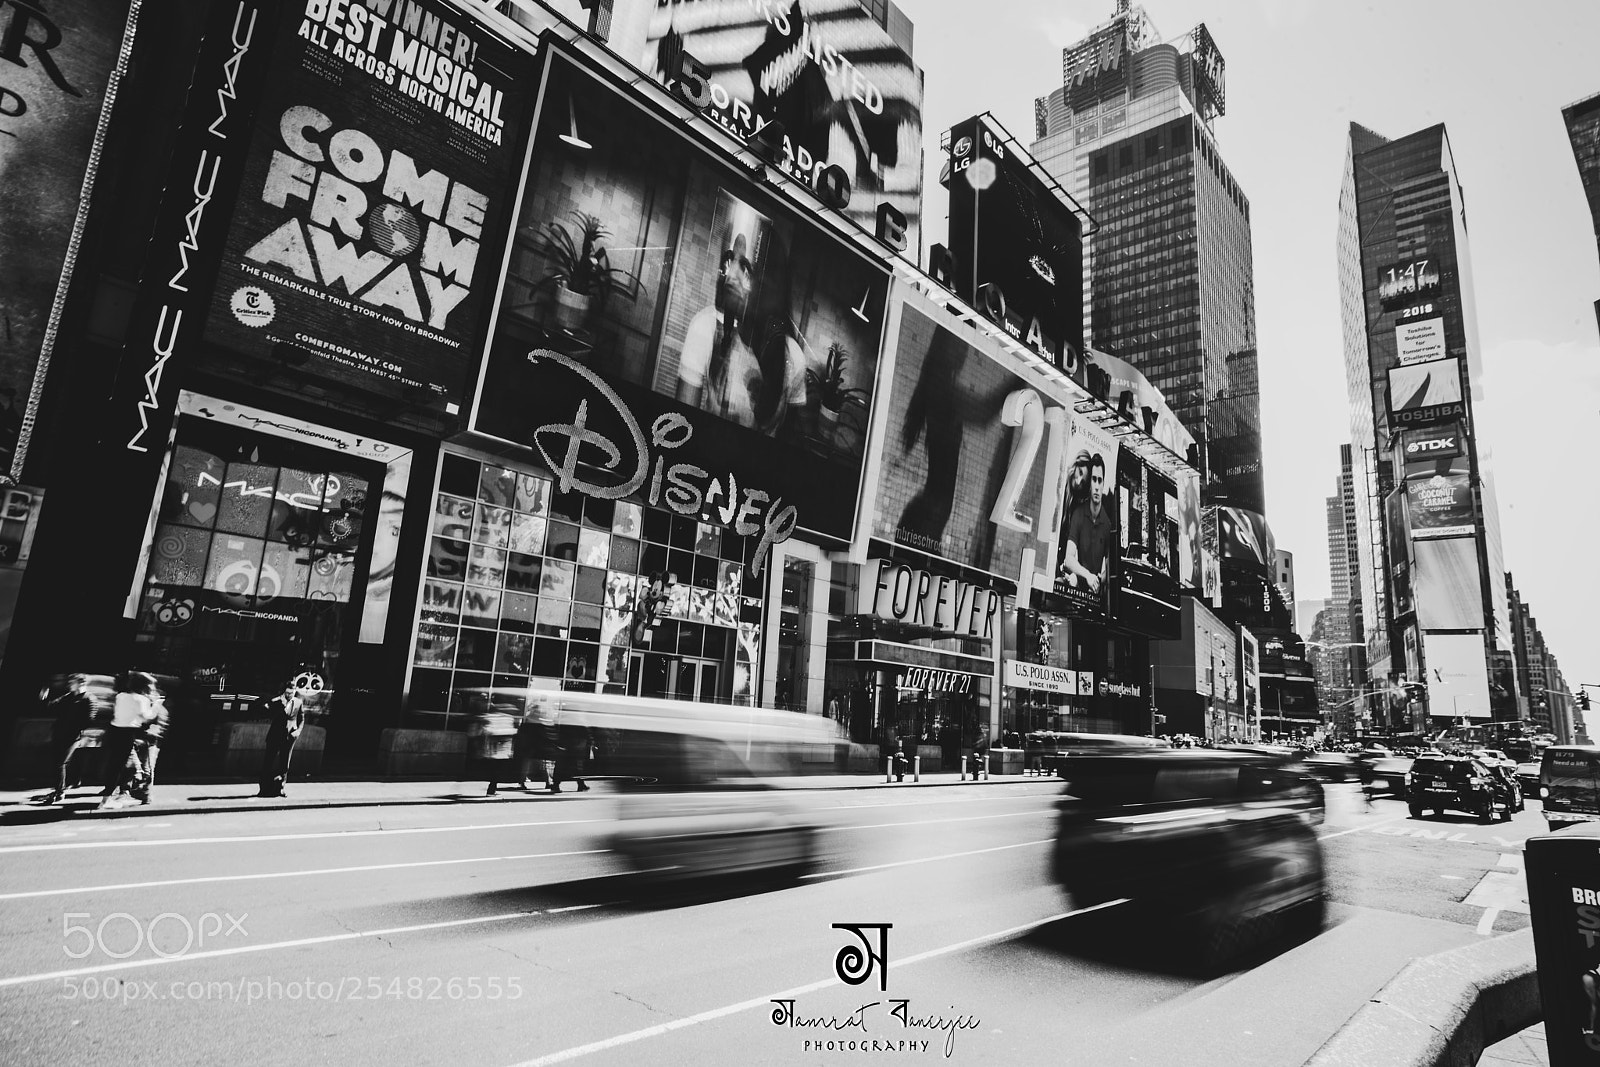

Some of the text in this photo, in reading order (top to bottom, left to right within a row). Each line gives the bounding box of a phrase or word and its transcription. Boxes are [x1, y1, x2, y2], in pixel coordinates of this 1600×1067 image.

[304, 0, 505, 128] BEST MUSICAL
[802, 21, 884, 115] LISTED
[297, 18, 503, 147] ALL ACROSS NORTH AMERICA
[993, 139, 1004, 159] LG
[279, 104, 491, 241] COME
[953, 157, 970, 173] LG
[244, 216, 471, 332] AWAY
[1386, 259, 1429, 282] 1:47
[240, 263, 461, 350] THE REMARKABLE TRUE STORY NOW ON BROADWAY
[1402, 303, 1433, 319] 2018
[1404, 331, 1437, 342] Solutions
[1407, 325, 1433, 334] Toshiba
[294, 332, 403, 374] COMEFROMAWAY.COM
[357, 363, 369, 372] 236
[369, 367, 388, 378] WEST
[1393, 404, 1464, 423] TOSHIBA
[294, 427, 343, 445] NICOPANDA
[1417, 437, 1455, 451] TDK
[859, 558, 1001, 640] FOREVER
[1263, 584, 1271, 612] 1500
[254, 612, 299, 623] NICOPANDA
[904, 667, 972, 694] FOREVER 21
[1015, 664, 1071, 684] U.S. POLO ASSN.
[1028, 680, 1045, 689] SINCE
